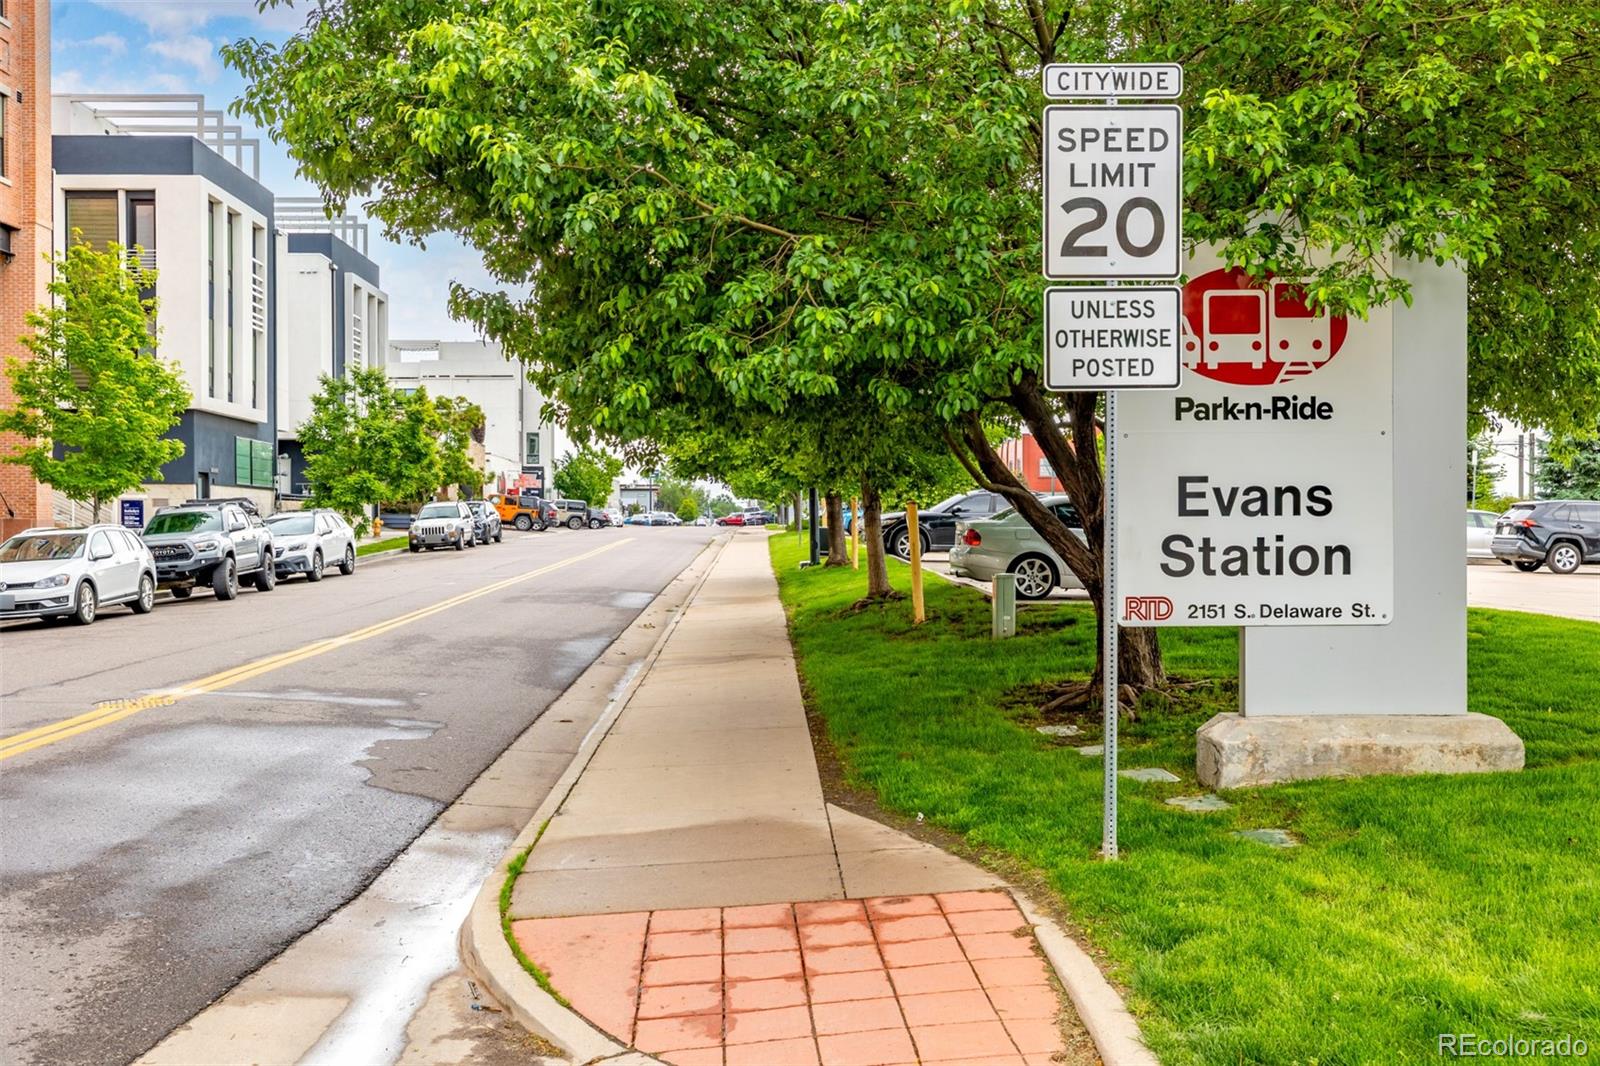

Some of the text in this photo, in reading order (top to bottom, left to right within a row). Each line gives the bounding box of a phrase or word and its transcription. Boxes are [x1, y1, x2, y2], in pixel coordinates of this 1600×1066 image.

[1057, 71, 1169, 91] CITYWIDE
[1057, 127, 1169, 153] SPEED
[1069, 162, 1156, 188] LIMIT
[1060, 196, 1165, 258] 20
[1071, 299, 1155, 320] UNLESS
[1055, 328, 1172, 349] OTHERWISE
[1072, 358, 1154, 378] POSTED
[1174, 395, 1334, 422] Park-n-Ride
[1177, 475, 1333, 518] Evans
[1159, 533, 1352, 578] Station
[1124, 596, 1174, 621] RTD
[1187, 602, 1376, 619] 2151 S. Delaware St.
